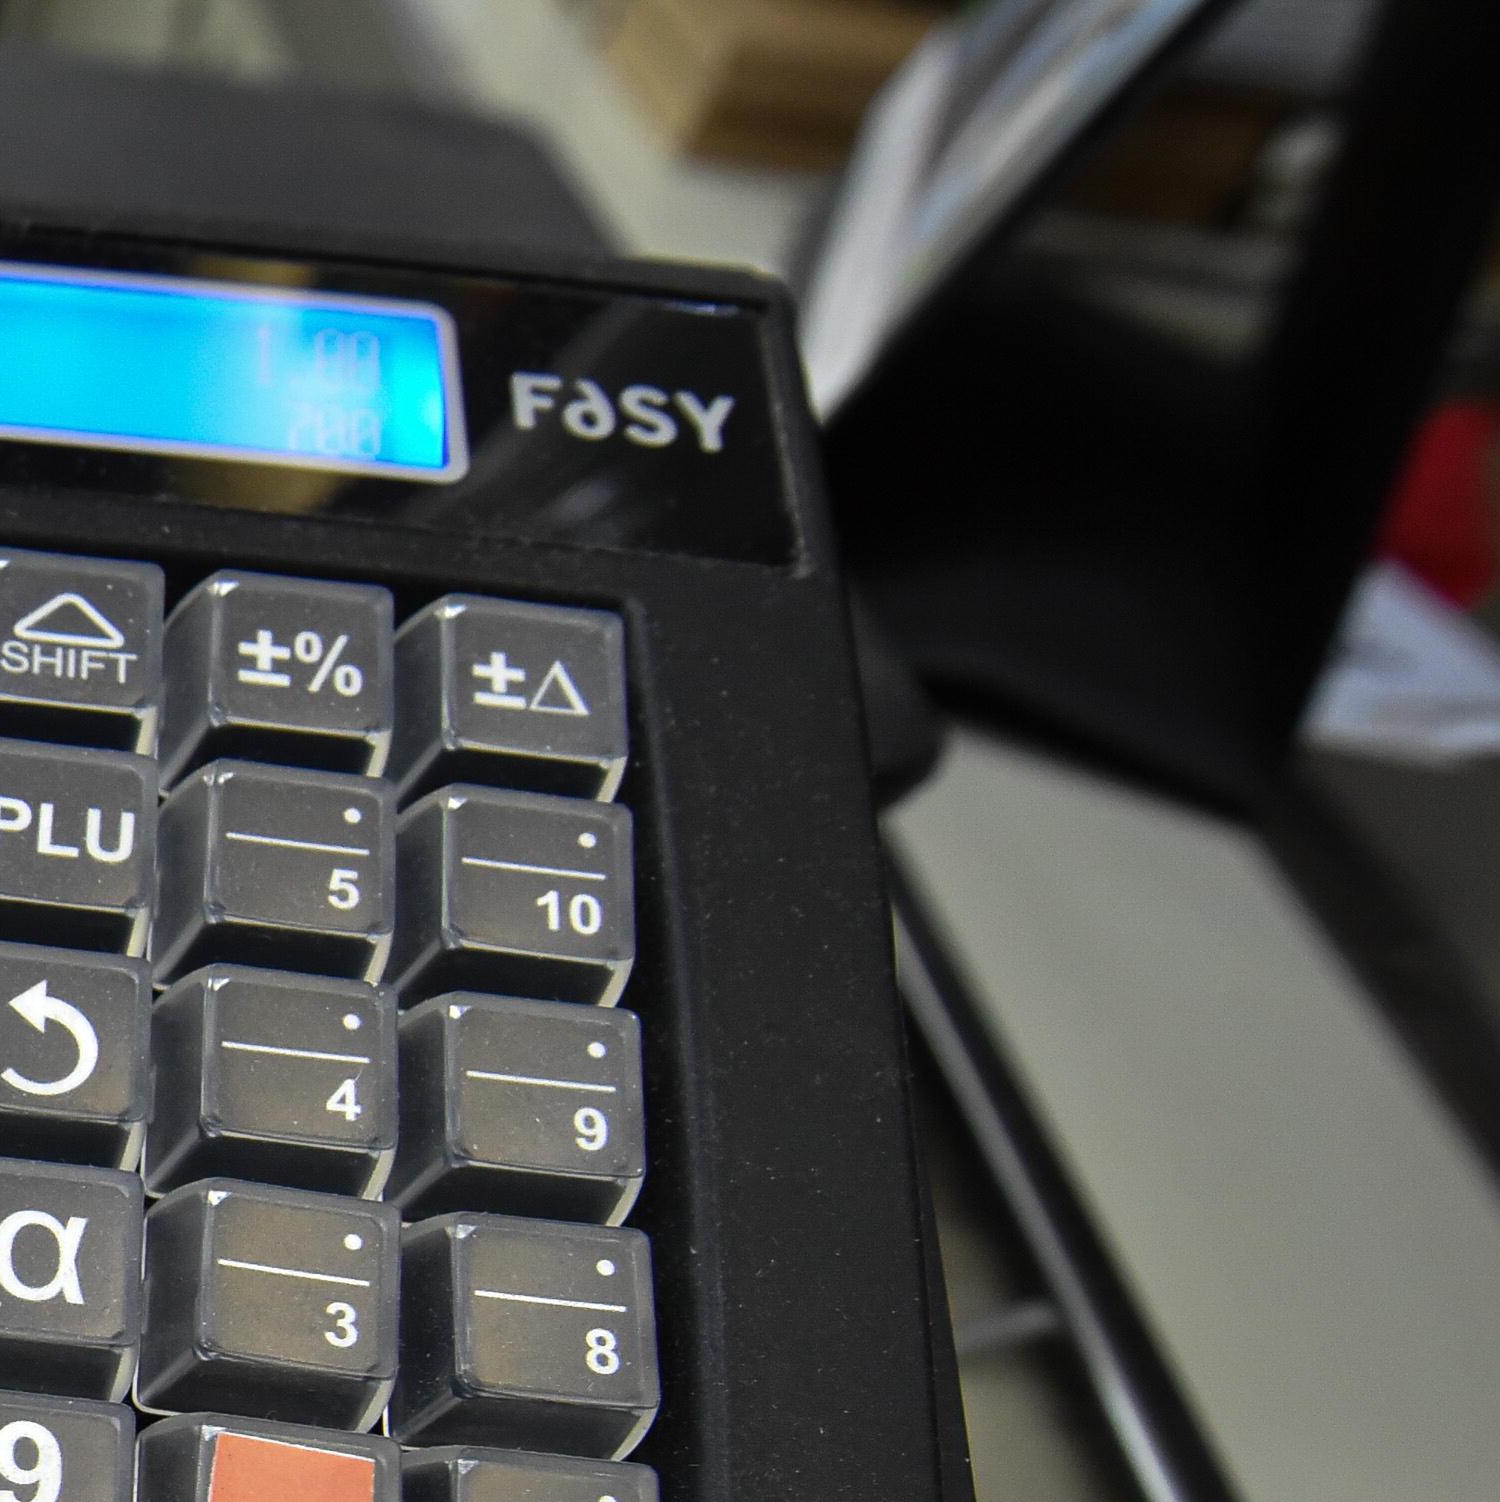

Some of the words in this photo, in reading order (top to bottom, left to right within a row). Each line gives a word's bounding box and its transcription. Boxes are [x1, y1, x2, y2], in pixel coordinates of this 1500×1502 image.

[0, 640, 138, 685] SHIFT
[327, 869, 360, 910] 5
[535, 889, 603, 935] 10
[325, 1077, 362, 1122] 4
[573, 1106, 608, 1151] 9
[324, 1302, 359, 1348] 3
[584, 1328, 620, 1376] 8
